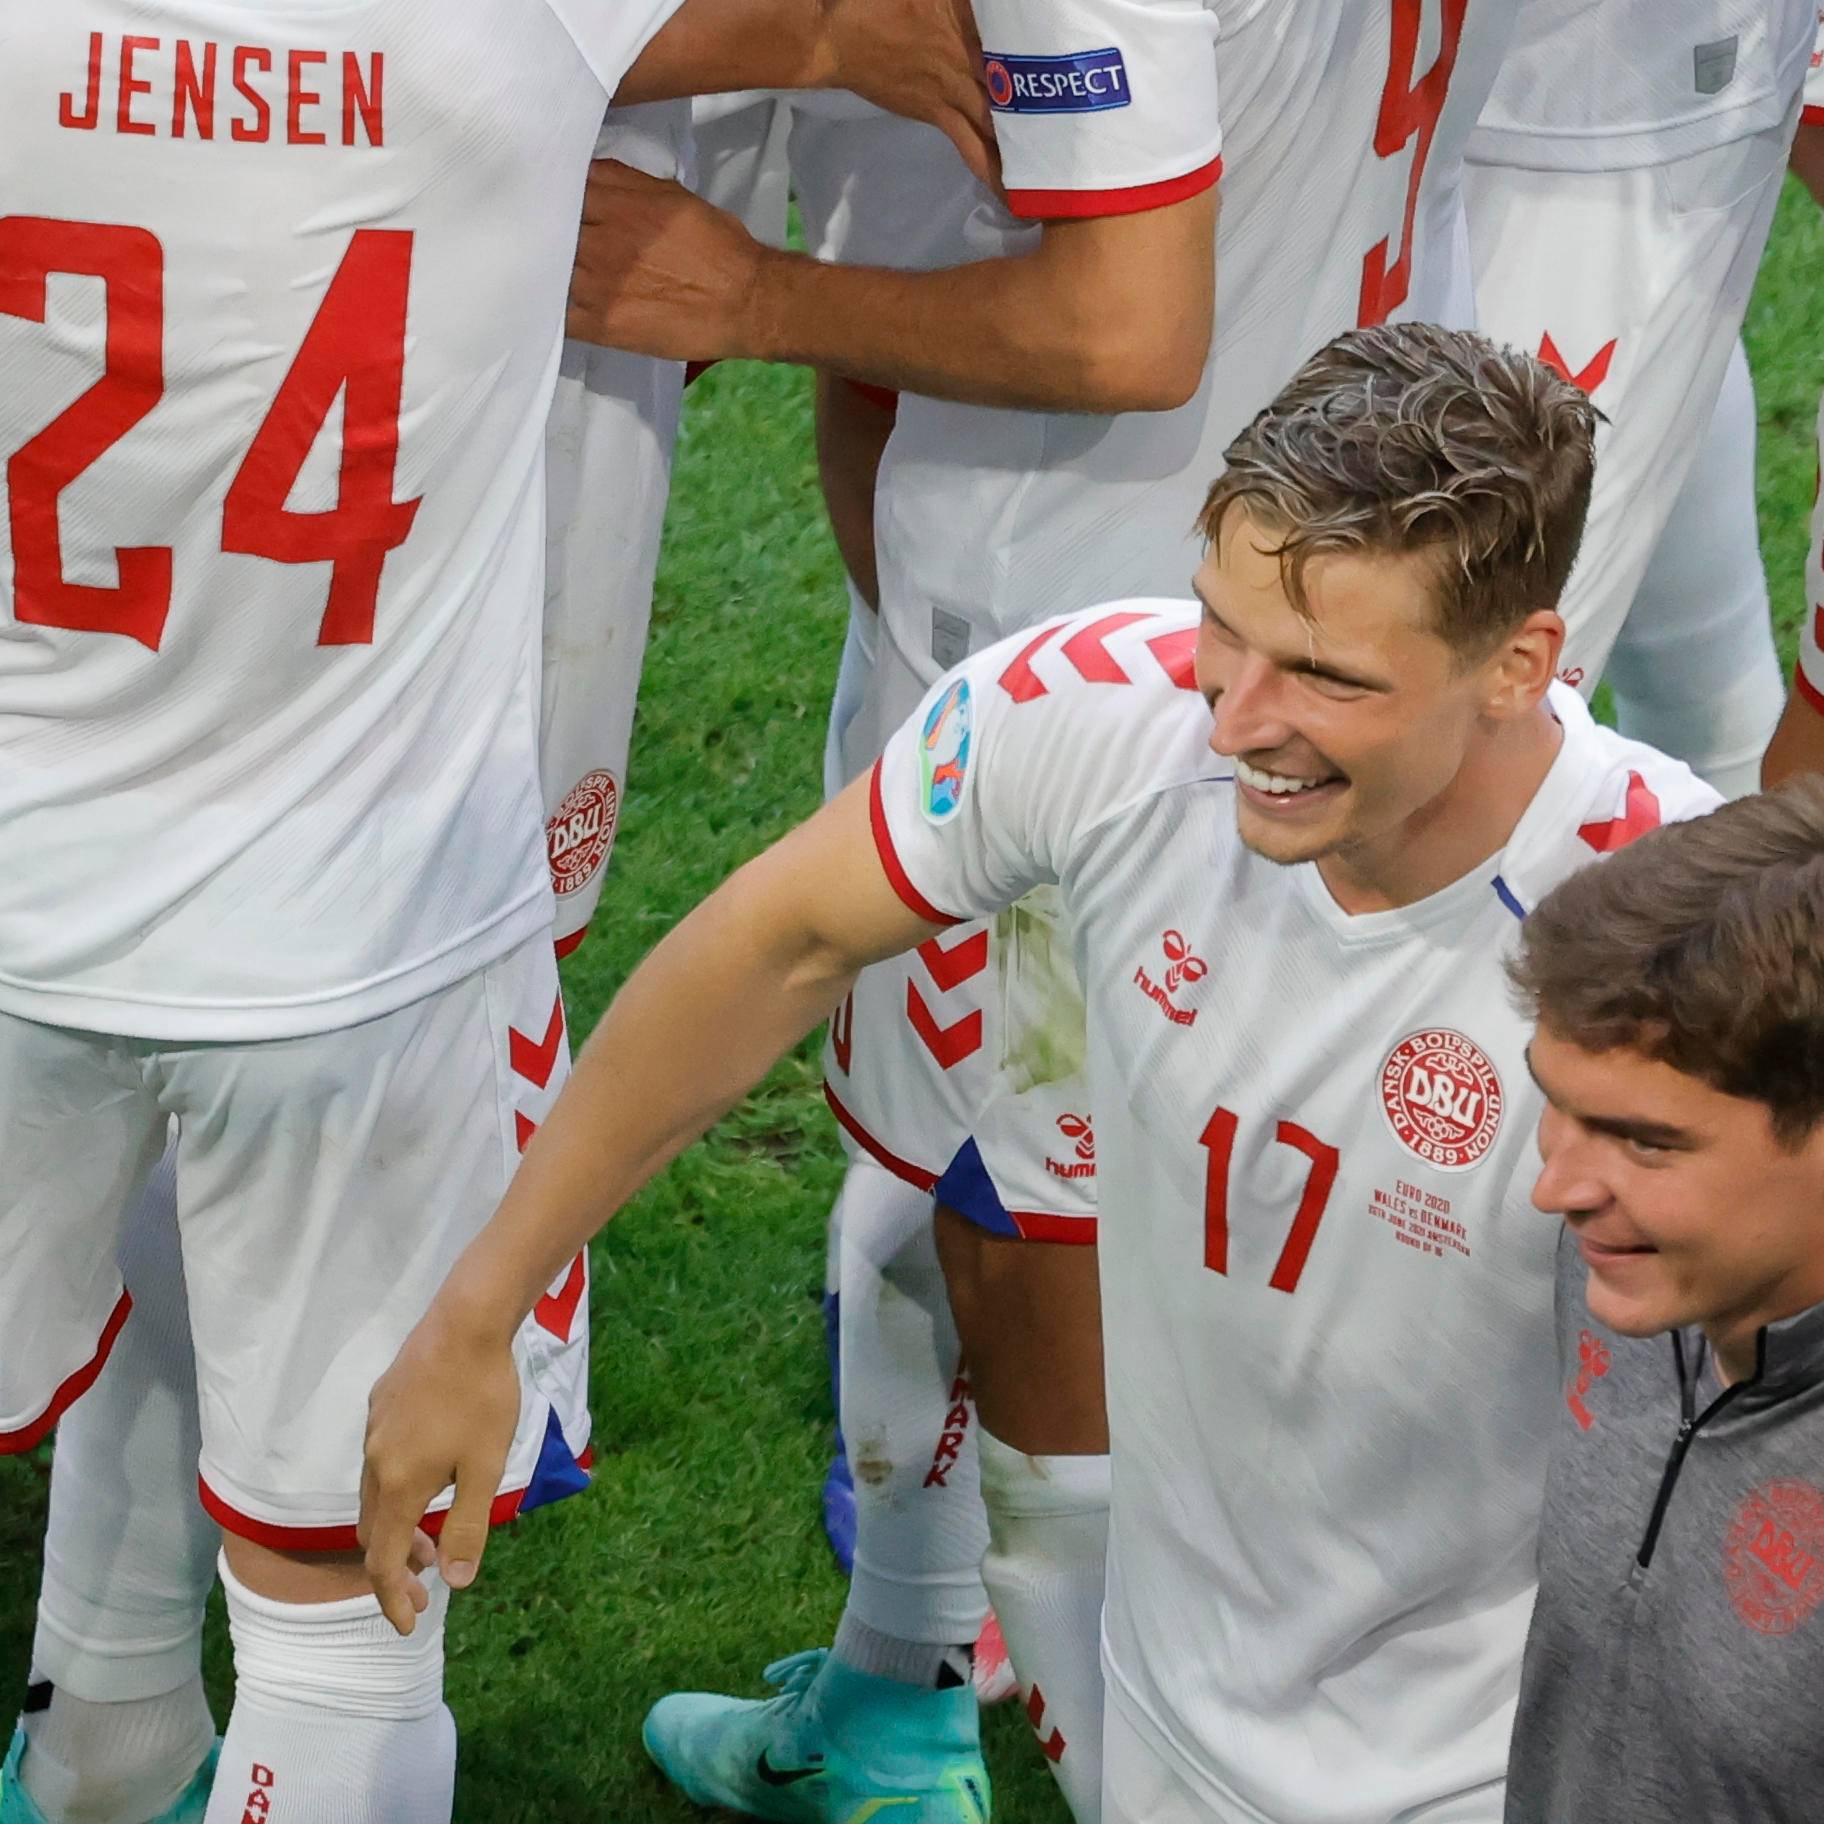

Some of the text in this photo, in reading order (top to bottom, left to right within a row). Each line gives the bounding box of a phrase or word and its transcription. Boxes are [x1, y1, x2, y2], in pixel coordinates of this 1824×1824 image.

[59, 31, 385, 148] JENSEN
[1013, 64, 1122, 98] RESPECT
[551, 802, 602, 859] DBU
[595, 790, 615, 856] UNION
[559, 863, 592, 893] 1889
[1133, 966, 1198, 1026] hummel
[1384, 1033, 1501, 1165] DANSK BOLDSPIL UNION 1889
[1405, 1064, 1482, 1129] DBU
[1045, 1156, 1096, 1180] hum
[1396, 1179, 1451, 1214] EURO 2020
[1197, 1105, 1340, 1294] 17
[1374, 1188, 1407, 1214] WALES
[1421, 1209, 1467, 1241] DENMARK
[923, 1368, 973, 1488] MARK
